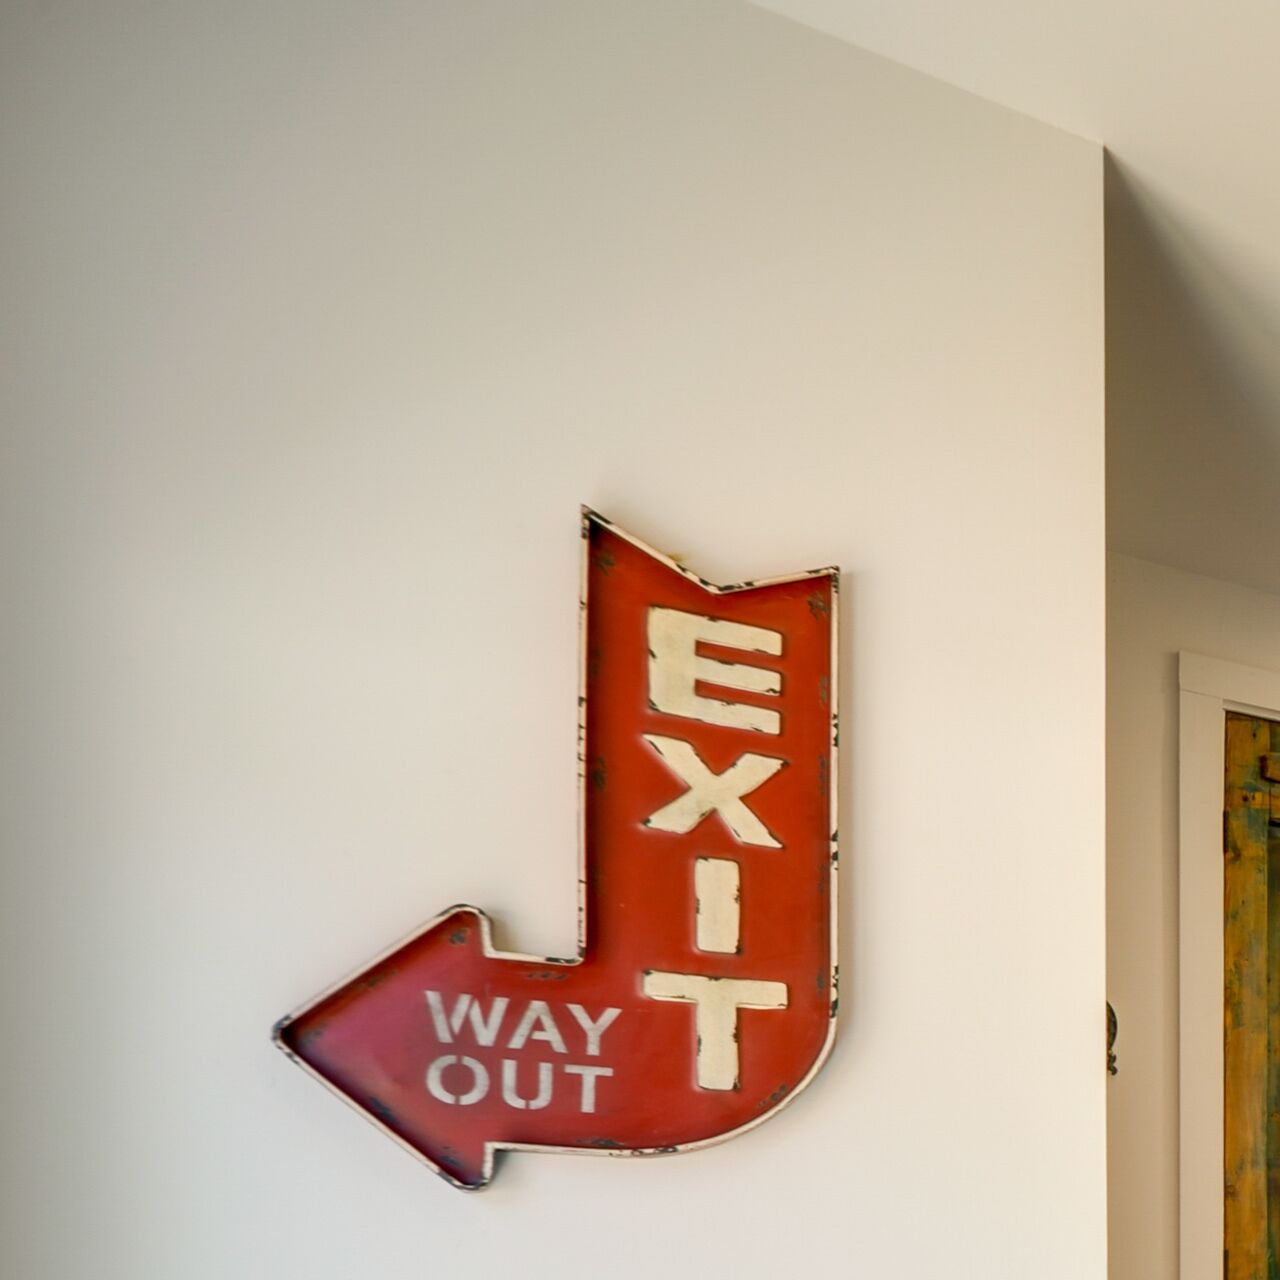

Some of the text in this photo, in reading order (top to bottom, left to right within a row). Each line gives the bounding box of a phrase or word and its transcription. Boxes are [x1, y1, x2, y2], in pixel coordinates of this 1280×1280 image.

[641, 605, 788, 1090] EXIT
[426, 990, 622, 1056] WAY
[426, 1054, 614, 1113] OUT
